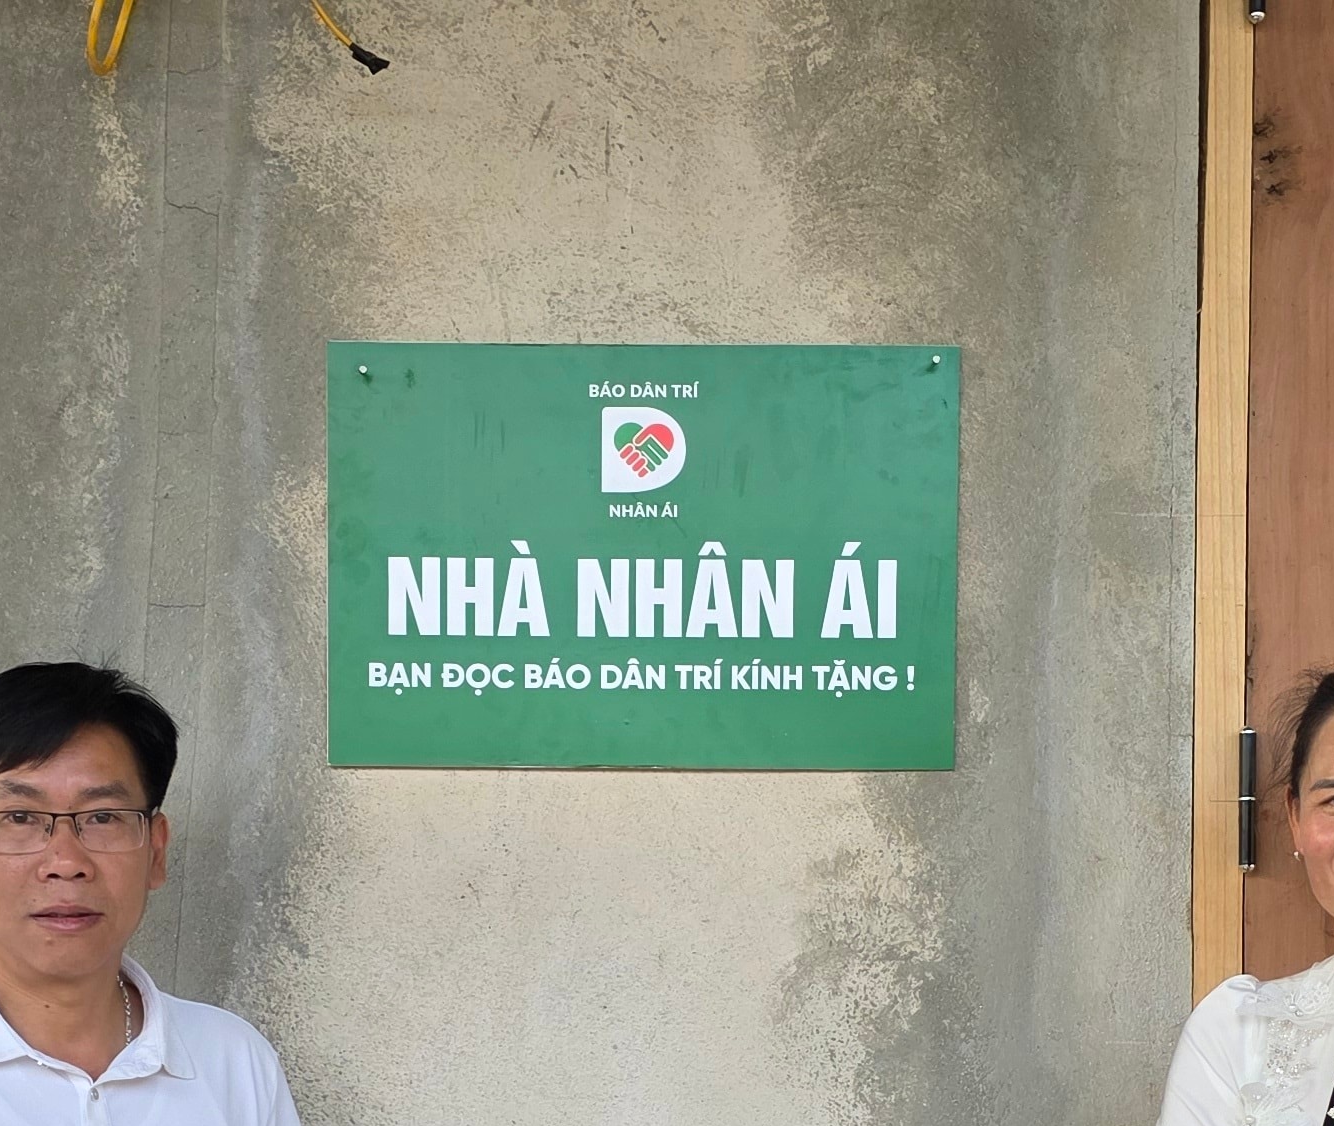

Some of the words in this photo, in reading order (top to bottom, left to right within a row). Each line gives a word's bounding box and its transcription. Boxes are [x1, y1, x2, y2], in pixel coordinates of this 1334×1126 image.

[588, 380, 625, 398] BÁO
[630, 381, 667, 398] DÂN
[670, 380, 700, 399] TRÍ
[609, 501, 658, 518] NHÂN
[660, 501, 678, 518] ÁI
[387, 539, 551, 637] NHÀ
[576, 541, 795, 638] NHÂN
[820, 541, 898, 639] ÁI
[368, 662, 432, 696] BẠN
[440, 662, 515, 697] ĐỌC
[524, 657, 592, 690] BÁO
[600, 657, 666, 690] DÂN
[674, 658, 724, 690] TRÍ
[731, 658, 803, 691] KÍNH
[811, 659, 898, 698] TẶNG
